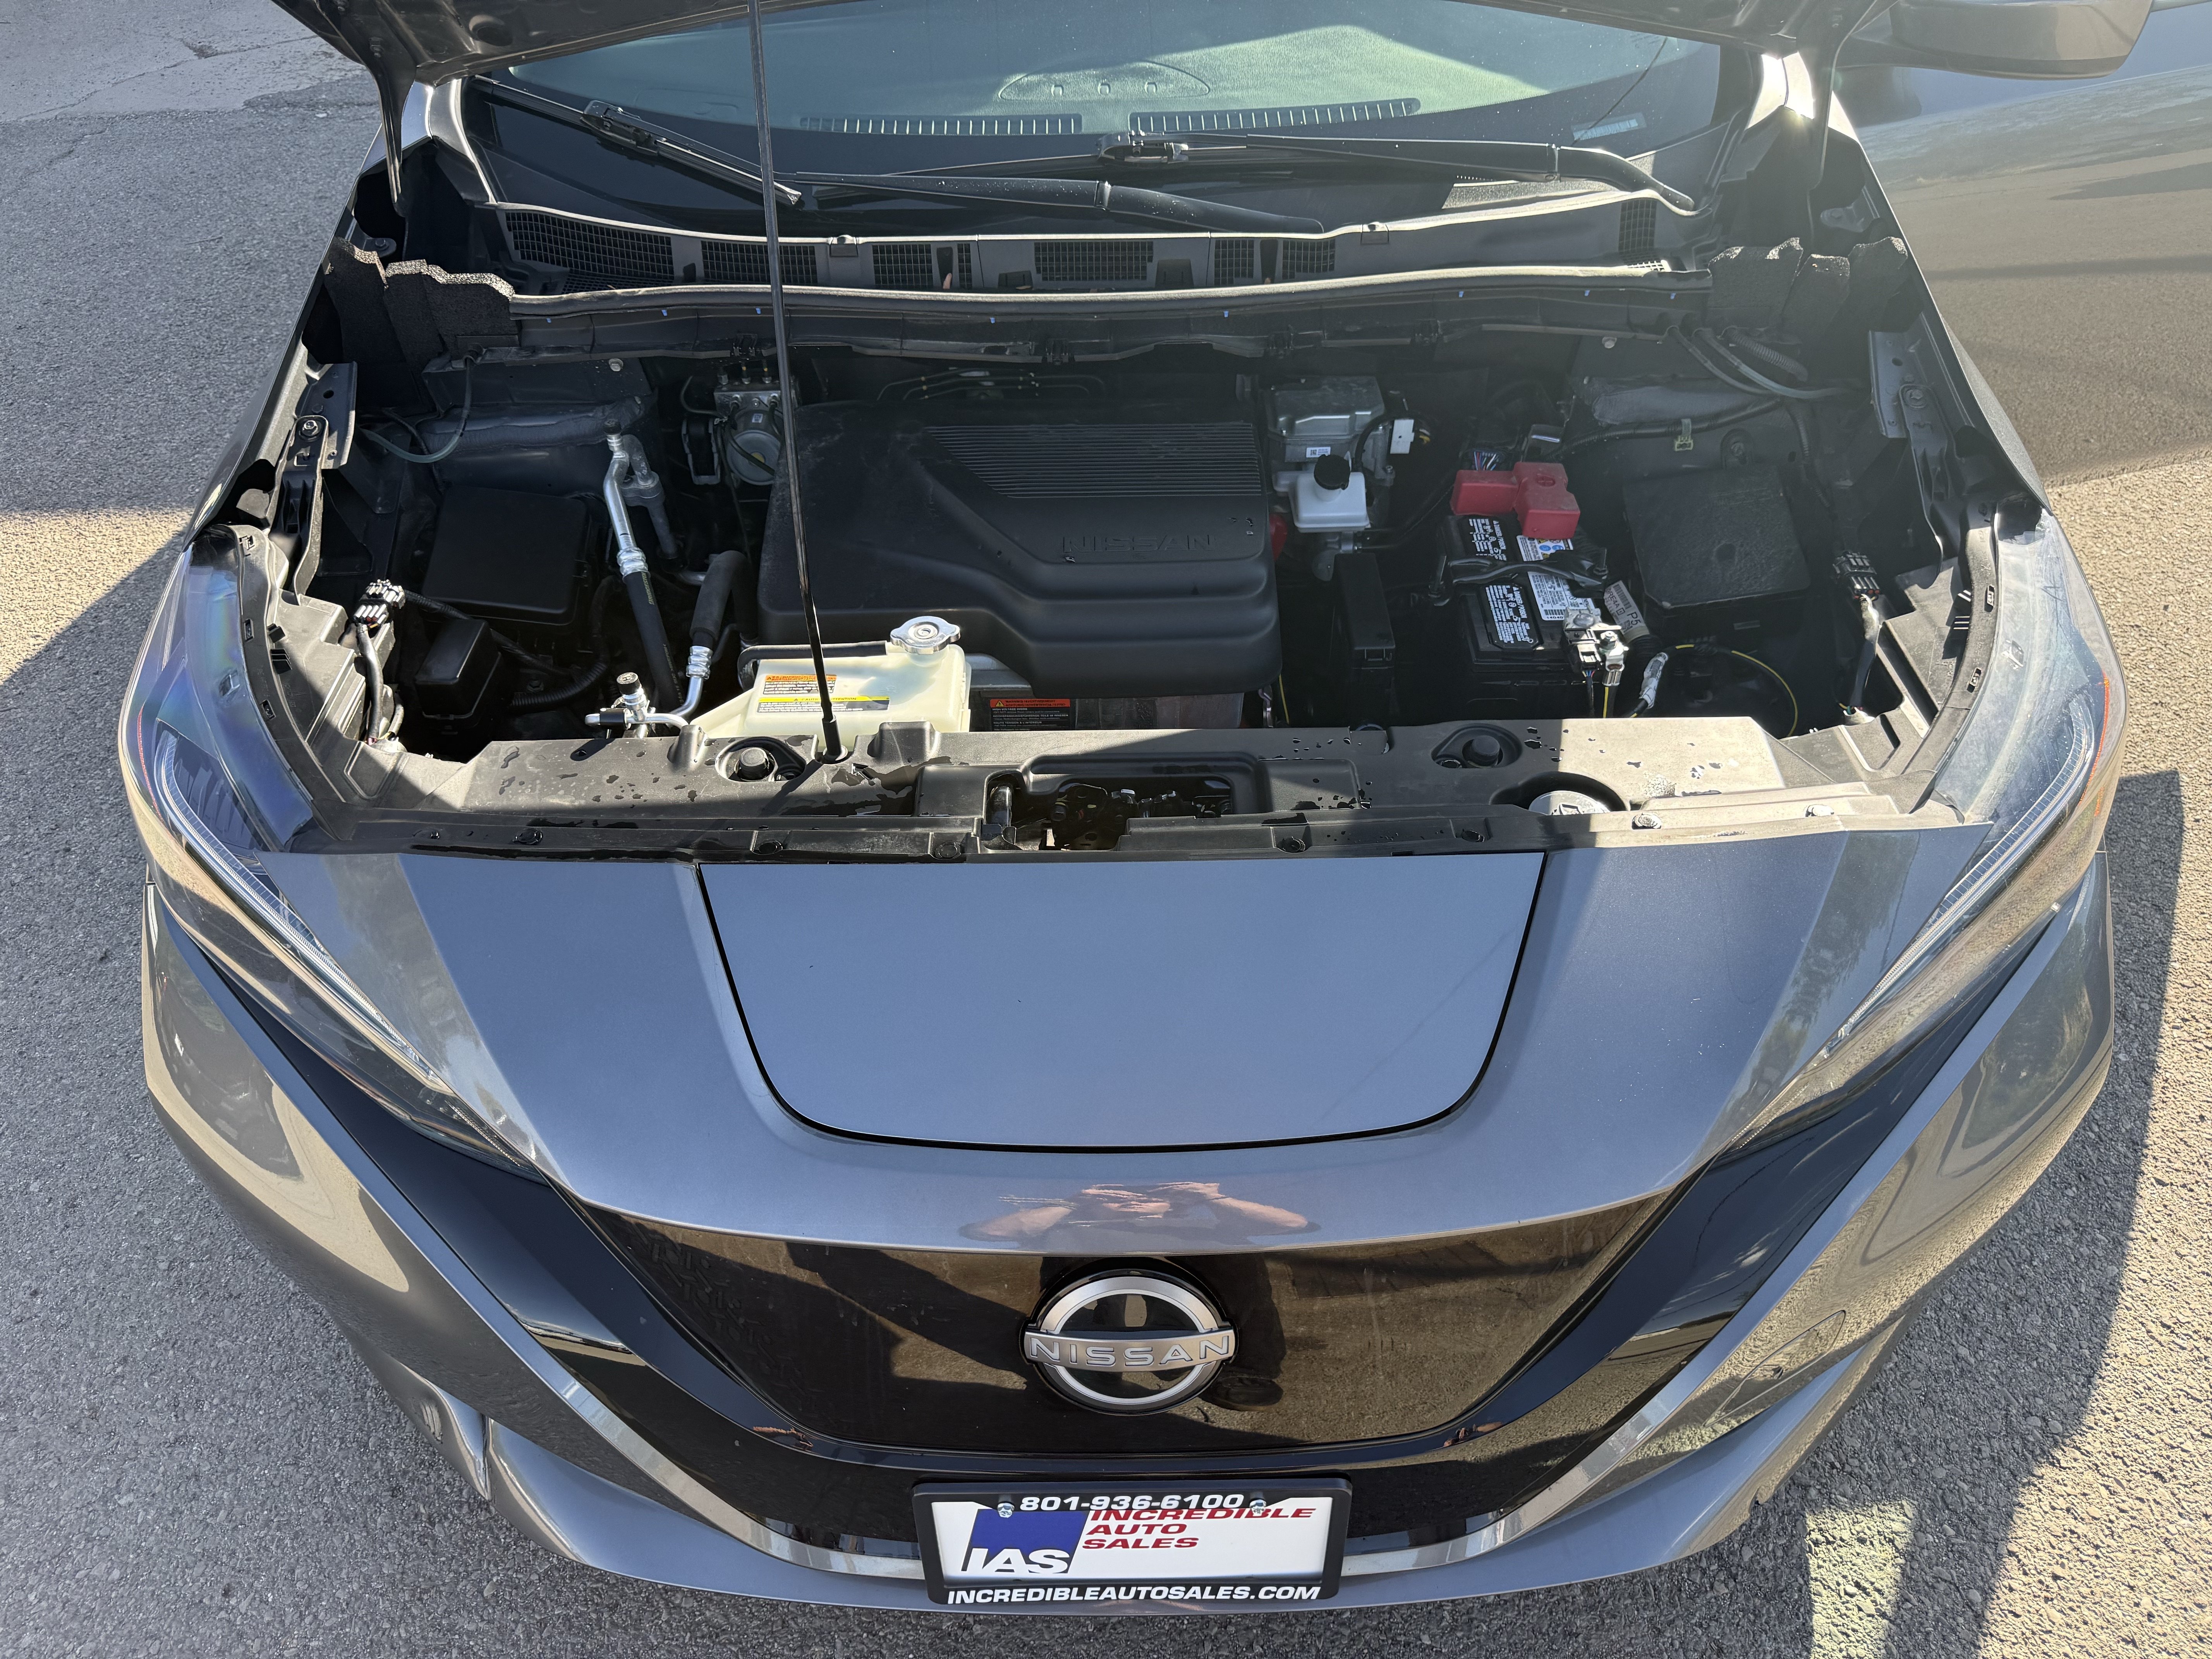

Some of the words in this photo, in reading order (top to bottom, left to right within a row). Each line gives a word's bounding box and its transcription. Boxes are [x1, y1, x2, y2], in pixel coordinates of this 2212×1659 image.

[1063, 534, 1215, 553] NISSAN
[1627, 612, 1641, 625] P5
[1030, 1335, 1229, 1367] NISSAN
[1020, 1494, 1244, 1511] 801-936-6100
[1091, 1508, 1316, 1521] INCREDIBLE
[1086, 1523, 1187, 1535] AUTO
[1082, 1537, 1199, 1549] SALES
[967, 1548, 1070, 1574] IAS
[948, 1586, 1321, 1604] INCREDIBLEAUTOSALES.COM
